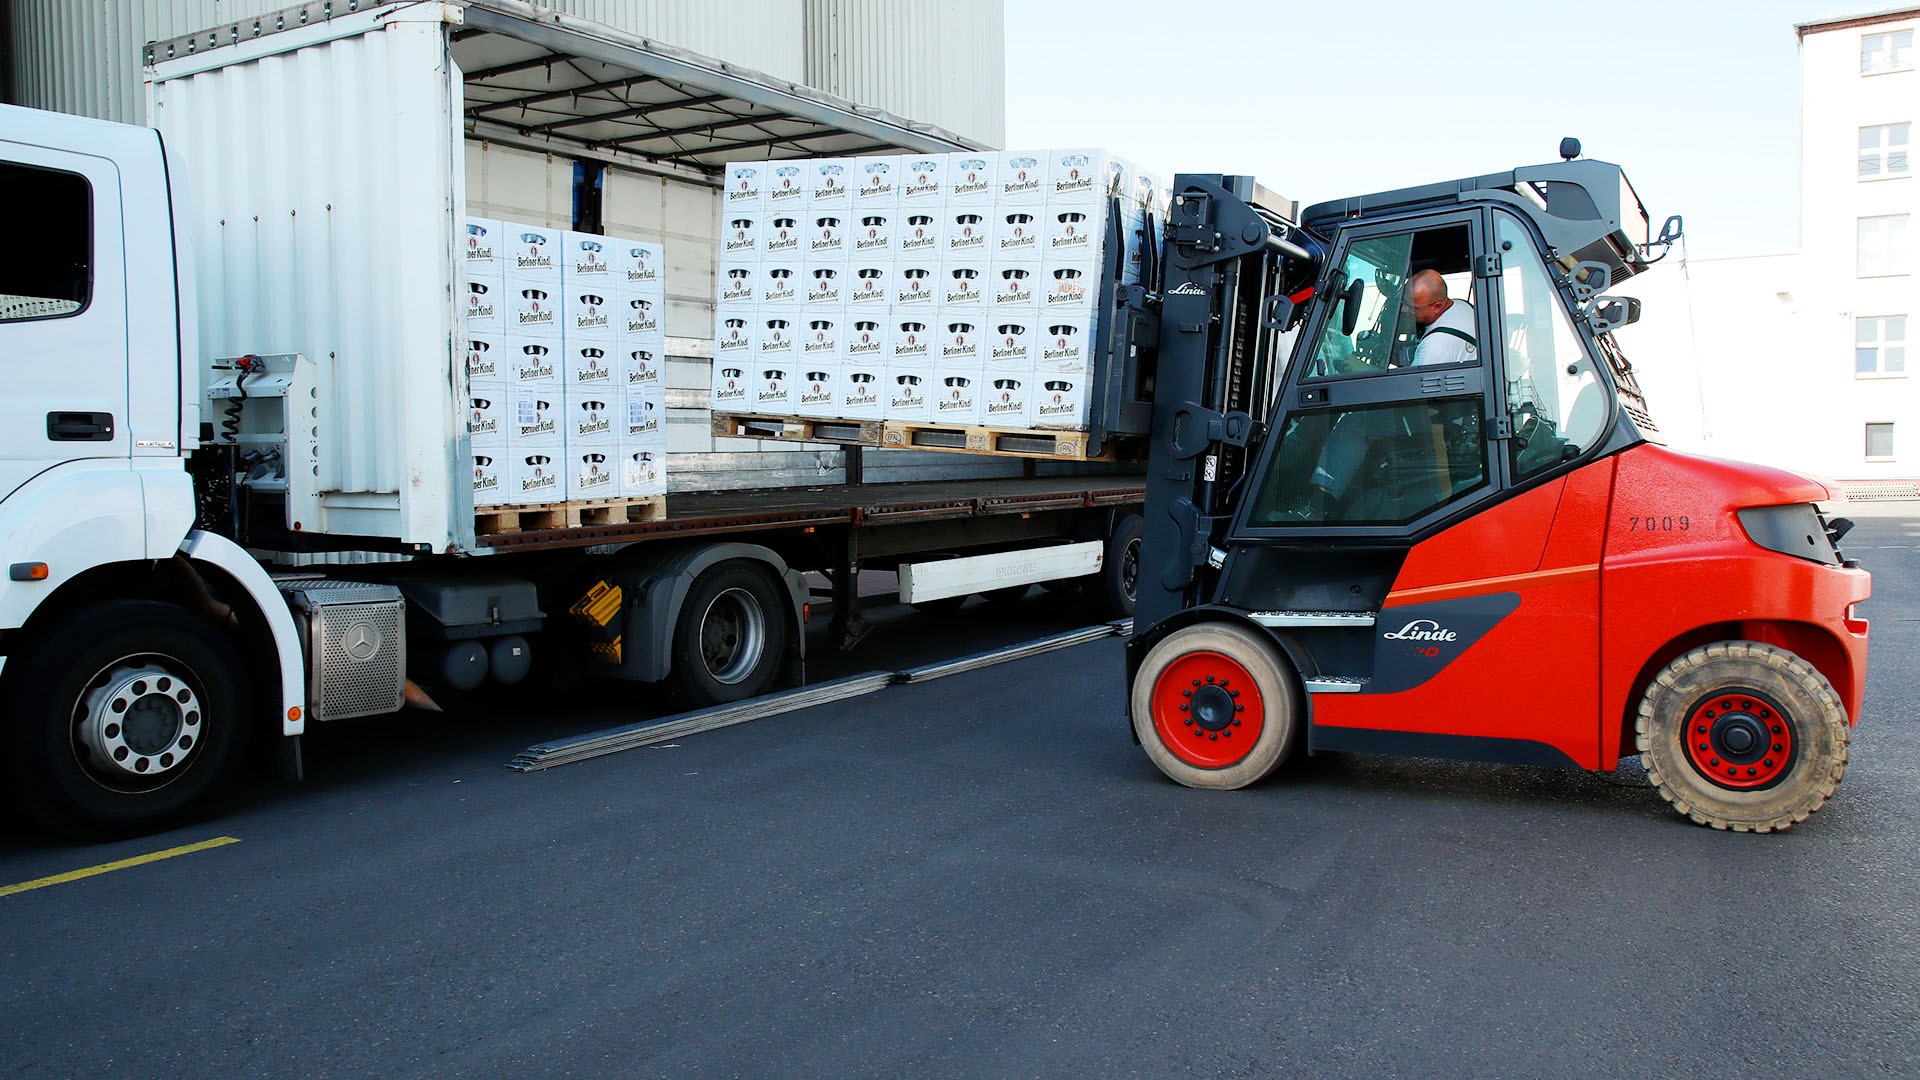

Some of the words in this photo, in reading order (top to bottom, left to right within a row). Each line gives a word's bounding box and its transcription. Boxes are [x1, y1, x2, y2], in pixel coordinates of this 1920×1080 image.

[860, 187, 878, 196] Berliner
[878, 184, 891, 194] Kindl
[906, 185, 925, 194] Berliner
[925, 182, 938, 192] Kindl
[955, 183, 974, 193] Berliner
[974, 180, 987, 190] Kindl
[1005, 183, 1025, 192] Berliner
[1024, 180, 1038, 190] Kindl
[1056, 181, 1077, 191] Berliner
[1077, 178, 1091, 188] Kindl
[730, 191, 746, 200] Berliner
[746, 189, 757, 198] Kindl
[772, 190, 789, 198] Berliner
[788, 187, 800, 196] Kindl
[815, 189, 833, 198] Berliner
[832, 186, 844, 196] Kindl
[727, 241, 743, 250] Berliner
[743, 238, 754, 248] Kindl
[769, 240, 785, 249] Berliner
[785, 238, 797, 247] Kindl
[812, 240, 829, 249] Berliner
[829, 238, 841, 247] Kindl
[857, 239, 875, 248] Berliner
[875, 236, 887, 246] Kindl
[903, 238, 922, 248] Berliner
[921, 235, 934, 245] Kindl
[951, 238, 970, 248] Berliner
[970, 235, 983, 245] Kindl
[1001, 238, 1021, 248] Berliner
[1021, 235, 1034, 245] Kindl
[1052, 237, 1073, 247] Berliner
[1073, 234, 1087, 244] Kindl
[477, 247, 492, 258] Kindl
[518, 257, 537, 267] Berliner
[537, 256, 550, 265] Kindl
[577, 263, 594, 272] Berliner
[594, 262, 607, 272] Kindl
[627, 269, 644, 279] Berliner
[644, 268, 655, 278] Kindl
[723, 290, 740, 299] Berliner
[739, 288, 751, 297] Kindl
[766, 291, 782, 300] Berliner
[782, 288, 794, 298] Kindl
[809, 291, 826, 300] Berliner
[826, 289, 838, 298] Kindl
[853, 291, 871, 300] Berliner
[871, 288, 884, 298] Kindl
[900, 291, 918, 301] Berliner
[918, 288, 931, 298] Kindl
[947, 292, 966, 301] Berliner
[966, 289, 979, 299] Kindl
[997, 293, 1017, 302] Berliner
[1017, 290, 1030, 300] Kindl
[1048, 293, 1069, 303] Berliner
[478, 305, 493, 316] Kindl
[519, 313, 539, 323] Berliner
[539, 310, 552, 321] Kindl
[578, 316, 595, 326] Berliner
[595, 315, 607, 324] Kindl
[628, 321, 645, 331] Berliner
[645, 318, 656, 329] Kindl
[721, 340, 737, 348] Berliner
[737, 337, 748, 346] Kindl
[762, 342, 779, 350] Berliner
[779, 339, 791, 348] Kindl
[805, 342, 822, 351] Berliner
[822, 339, 834, 349] Kindl
[850, 343, 868, 352] Berliner
[868, 340, 880, 350] Kindl
[896, 345, 914, 354] Berliner
[914, 342, 927, 352] Kindl
[943, 346, 962, 355] Berliner
[962, 343, 976, 353] Kindl
[992, 348, 1012, 357] Berliner
[1012, 344, 1026, 355] Kindl
[1044, 348, 1064, 358] Berliner
[1064, 345, 1078, 356] Kindl
[480, 362, 495, 373] Kindl
[520, 369, 540, 379] Berliner
[539, 365, 553, 376] Kindl
[579, 371, 596, 381] Berliner
[596, 368, 608, 379] Kindl
[629, 372, 645, 382] Berliner
[645, 369, 656, 380] Kindl
[717, 389, 733, 398] Berliner
[733, 387, 744, 396] Kindl
[759, 392, 775, 400] Berliner
[775, 389, 787, 398] Kindl
[802, 394, 819, 403] Berliner
[818, 391, 830, 400] Kindl
[846, 395, 864, 404] Berliner
[864, 393, 876, 402] Kindl
[892, 397, 910, 406] Berliner
[910, 394, 923, 404] Kindl
[940, 400, 958, 409] Berliner
[958, 397, 971, 407] Kindl
[989, 402, 1008, 412] Berliner
[1008, 399, 1022, 409] Kindl
[1040, 404, 1060, 414] Berliner
[1060, 401, 1074, 411] Kindl
[481, 419, 496, 431] Kindl
[541, 419, 554, 431] Kindl
[580, 423, 597, 434] Berliner
[597, 419, 609, 431] Kindl
[646, 419, 657, 430] Kindl
[482, 475, 497, 488] Kindl
[522, 480, 542, 490] Berliner
[542, 474, 555, 486] Kindl
[598, 472, 610, 484] Kindl
[1630, 516, 1690, 531] 7009
[1384, 620, 1456, 641] Linde
